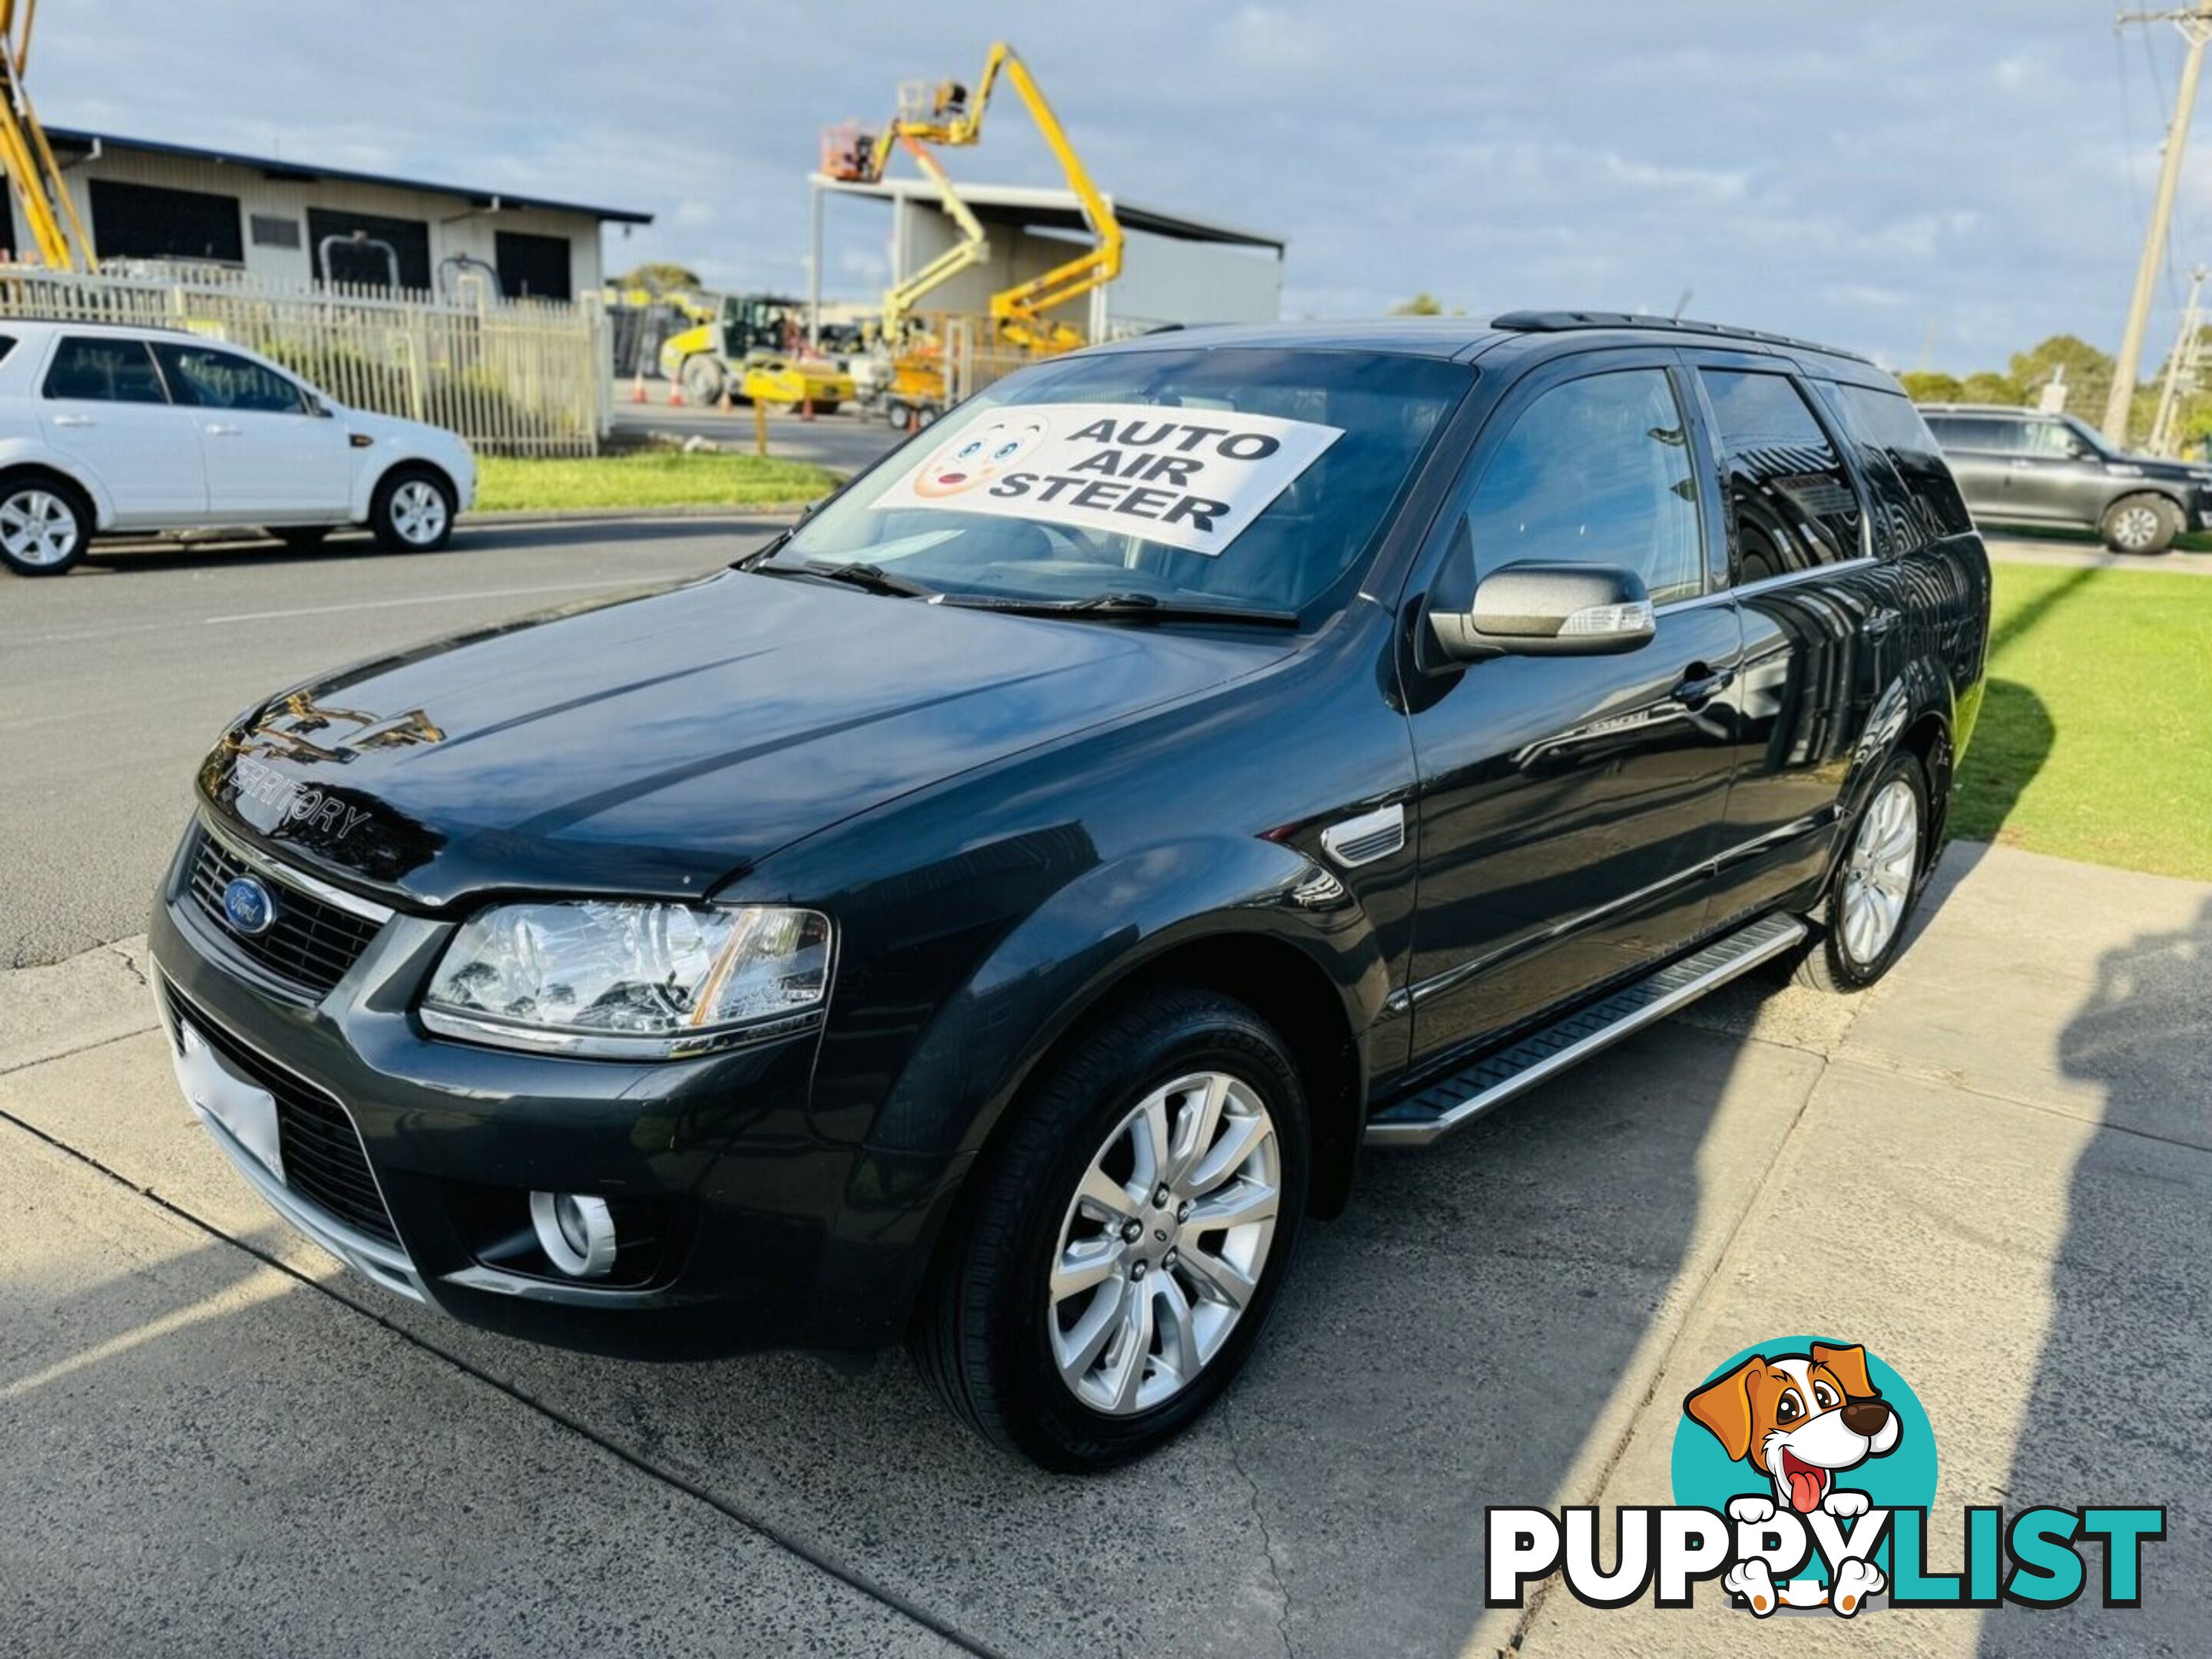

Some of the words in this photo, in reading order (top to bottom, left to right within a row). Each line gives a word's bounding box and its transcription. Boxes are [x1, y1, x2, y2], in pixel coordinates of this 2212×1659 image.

[1066, 419, 1280, 460] AUTO
[1069, 451, 1205, 487] AIR
[989, 473, 1230, 532] STEER
[230, 886, 260, 922] Ford
